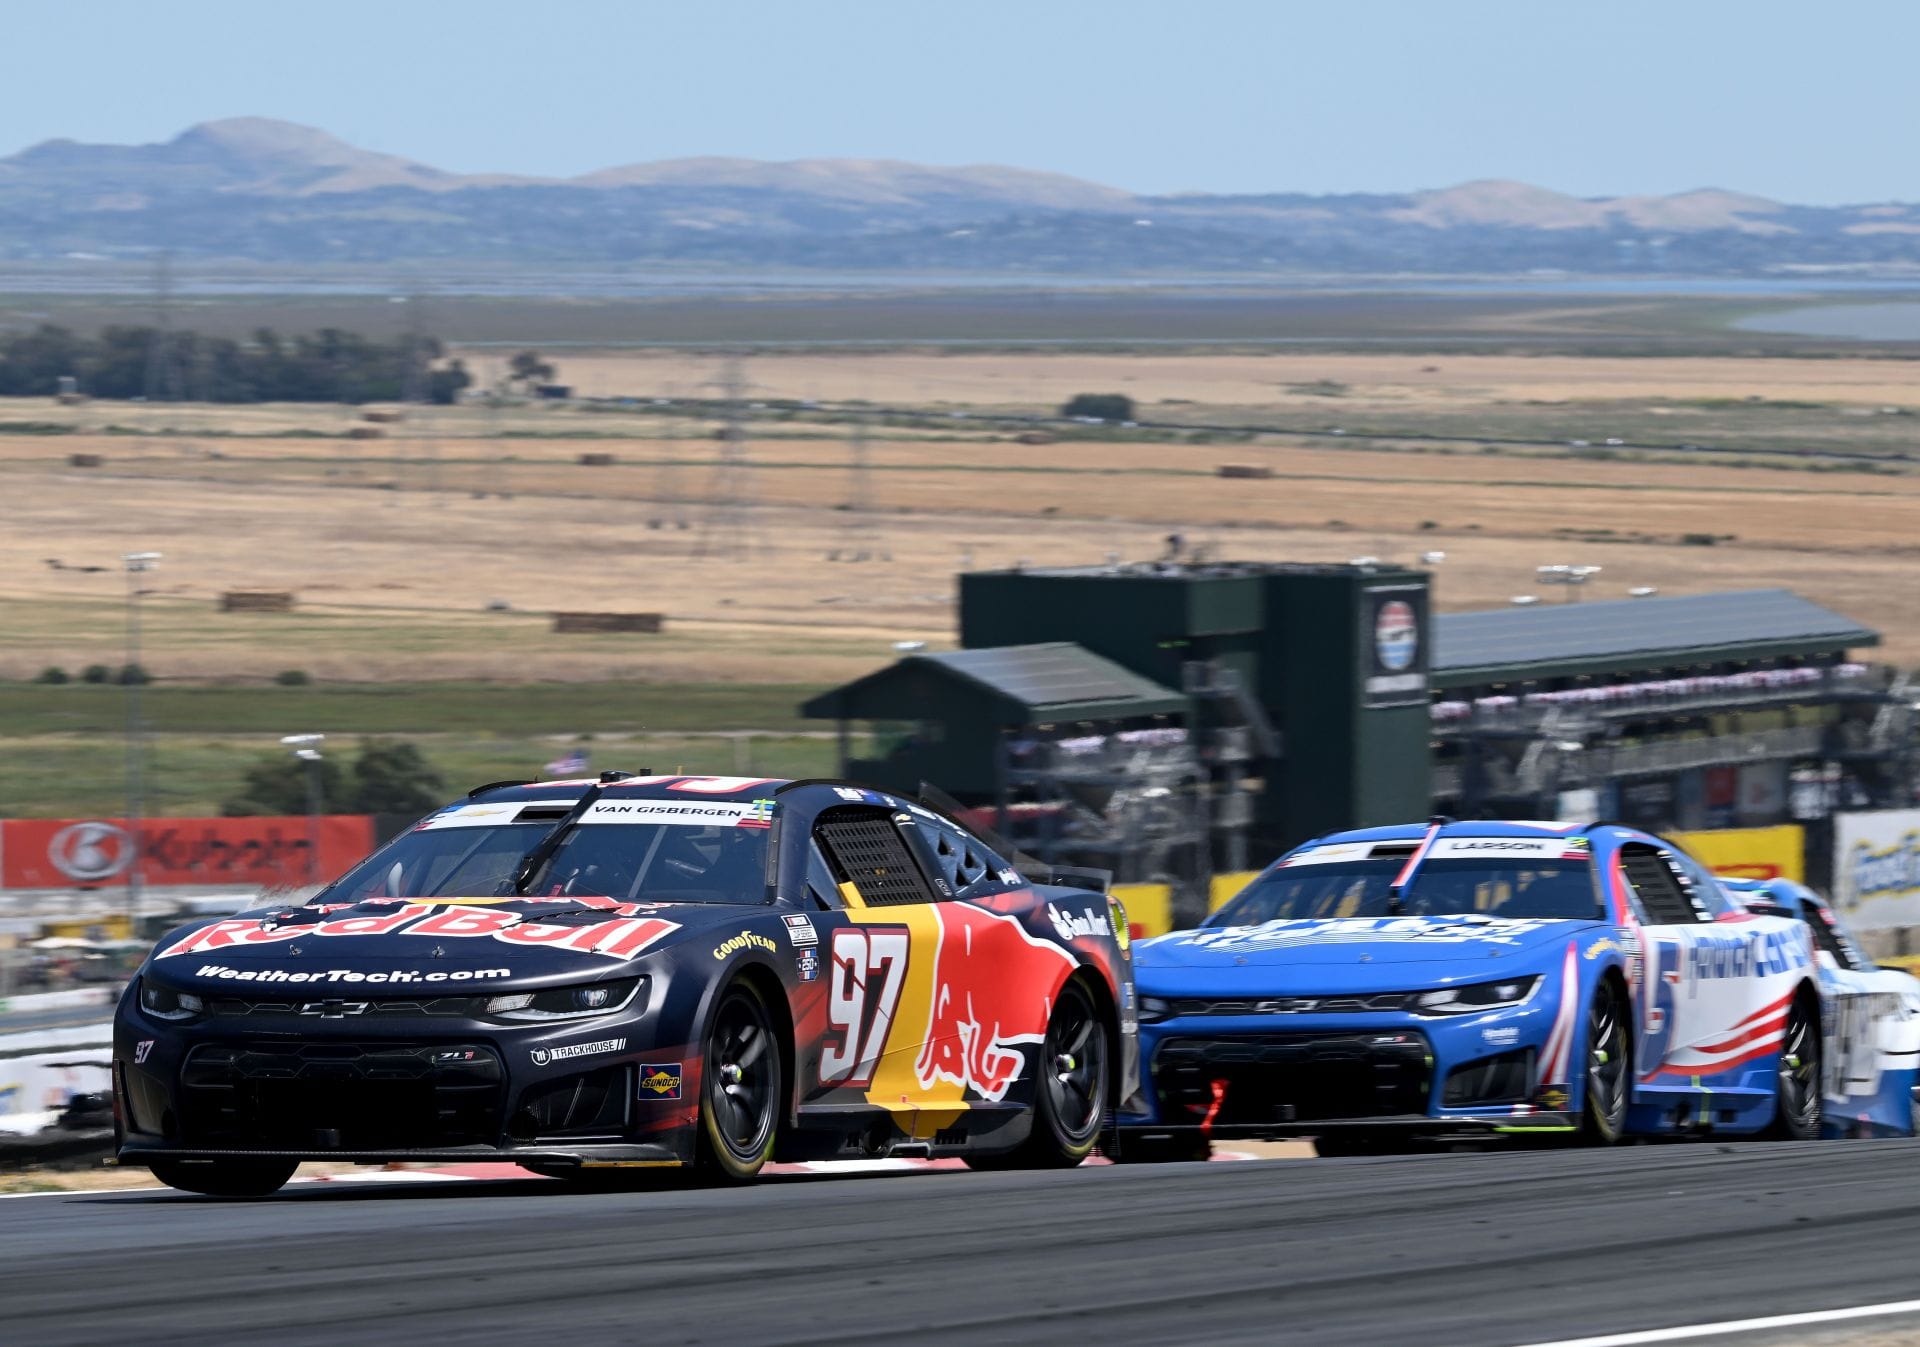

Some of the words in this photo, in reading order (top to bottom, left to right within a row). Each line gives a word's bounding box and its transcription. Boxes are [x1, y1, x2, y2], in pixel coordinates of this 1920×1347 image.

[637, 806, 742, 817] GISBERGEN
[1451, 842, 1545, 851] LARSON
[154, 903, 433, 960] Red
[713, 930, 777, 961] GOODYEAR
[195, 965, 511, 983] WeatherTech.com
[817, 928, 911, 1088] 97
[134, 1040, 155, 1064] 97
[555, 1041, 615, 1060] TRACKHOUSE
[643, 1076, 680, 1088] SUNOCO
